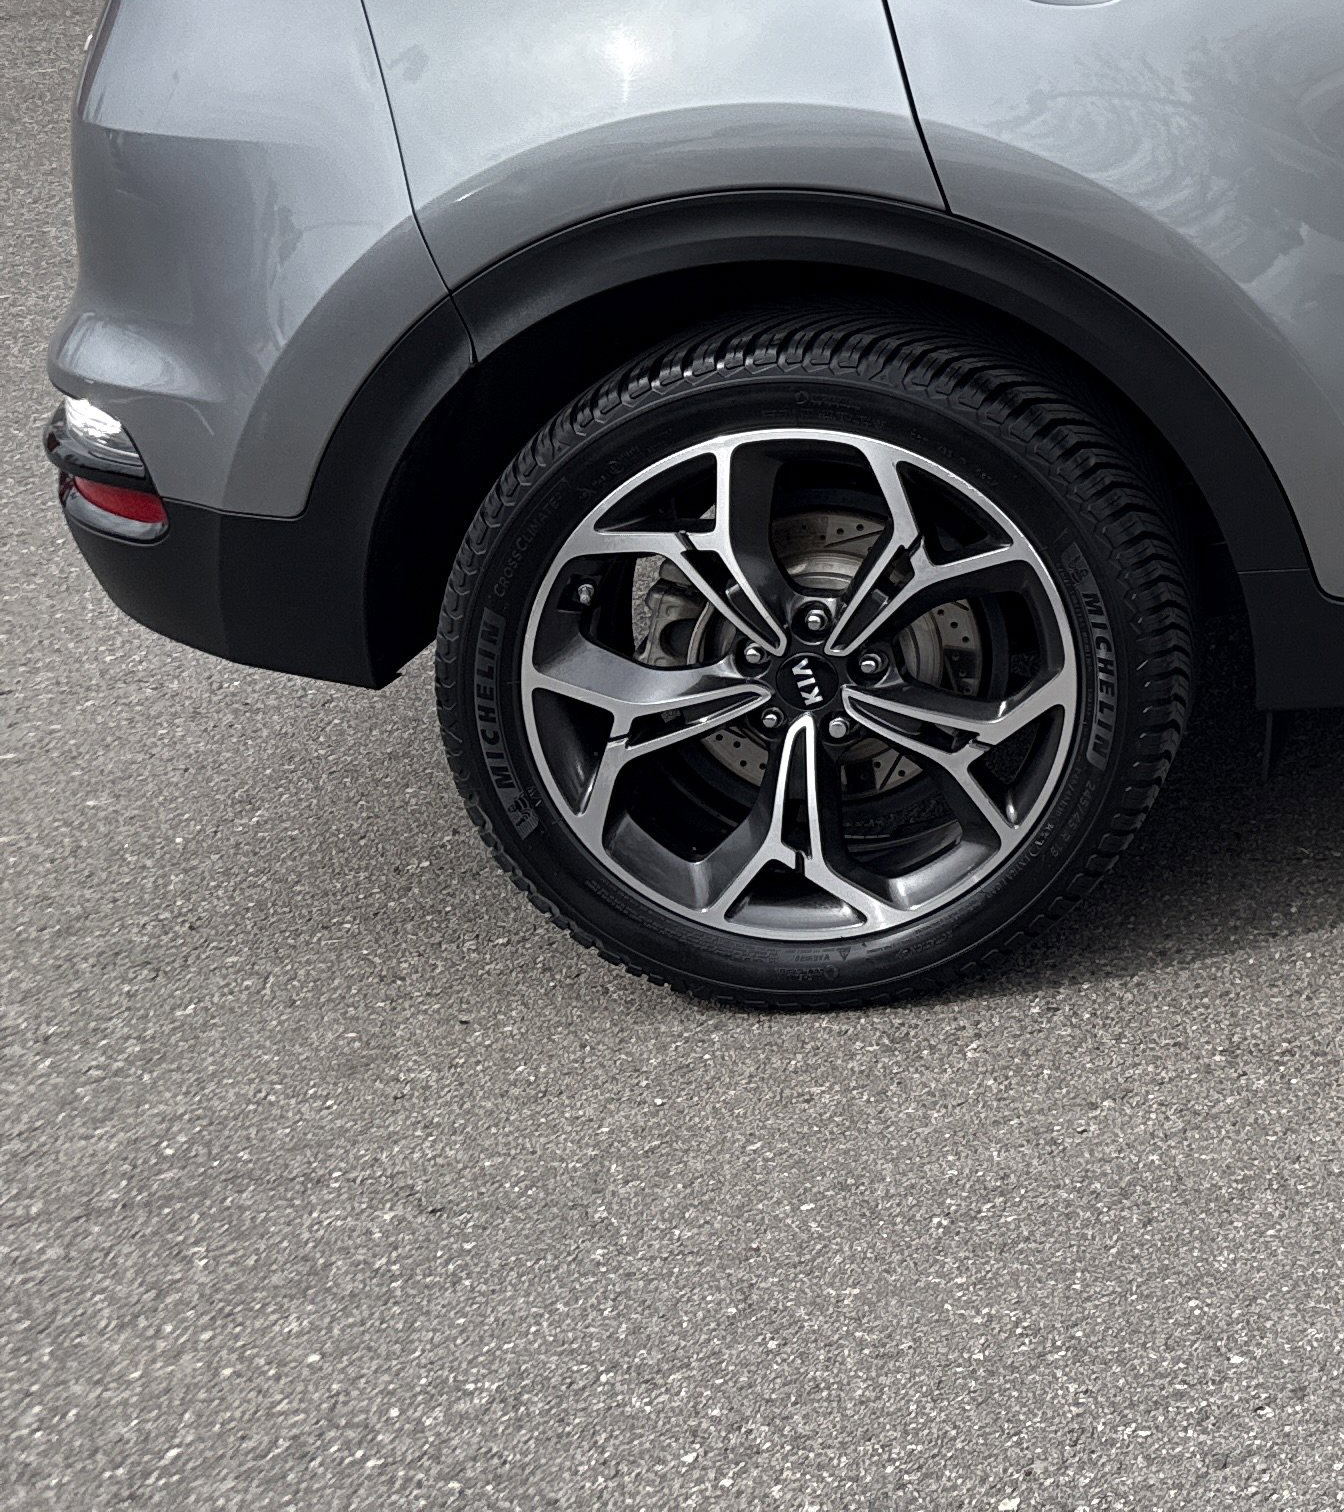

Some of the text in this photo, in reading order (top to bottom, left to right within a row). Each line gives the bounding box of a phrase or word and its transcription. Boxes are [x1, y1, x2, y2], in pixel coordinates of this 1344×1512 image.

[477, 622, 516, 789] MICHELIN
[792, 658, 823, 706] KIA
[1082, 592, 1115, 760] MICHELIN
